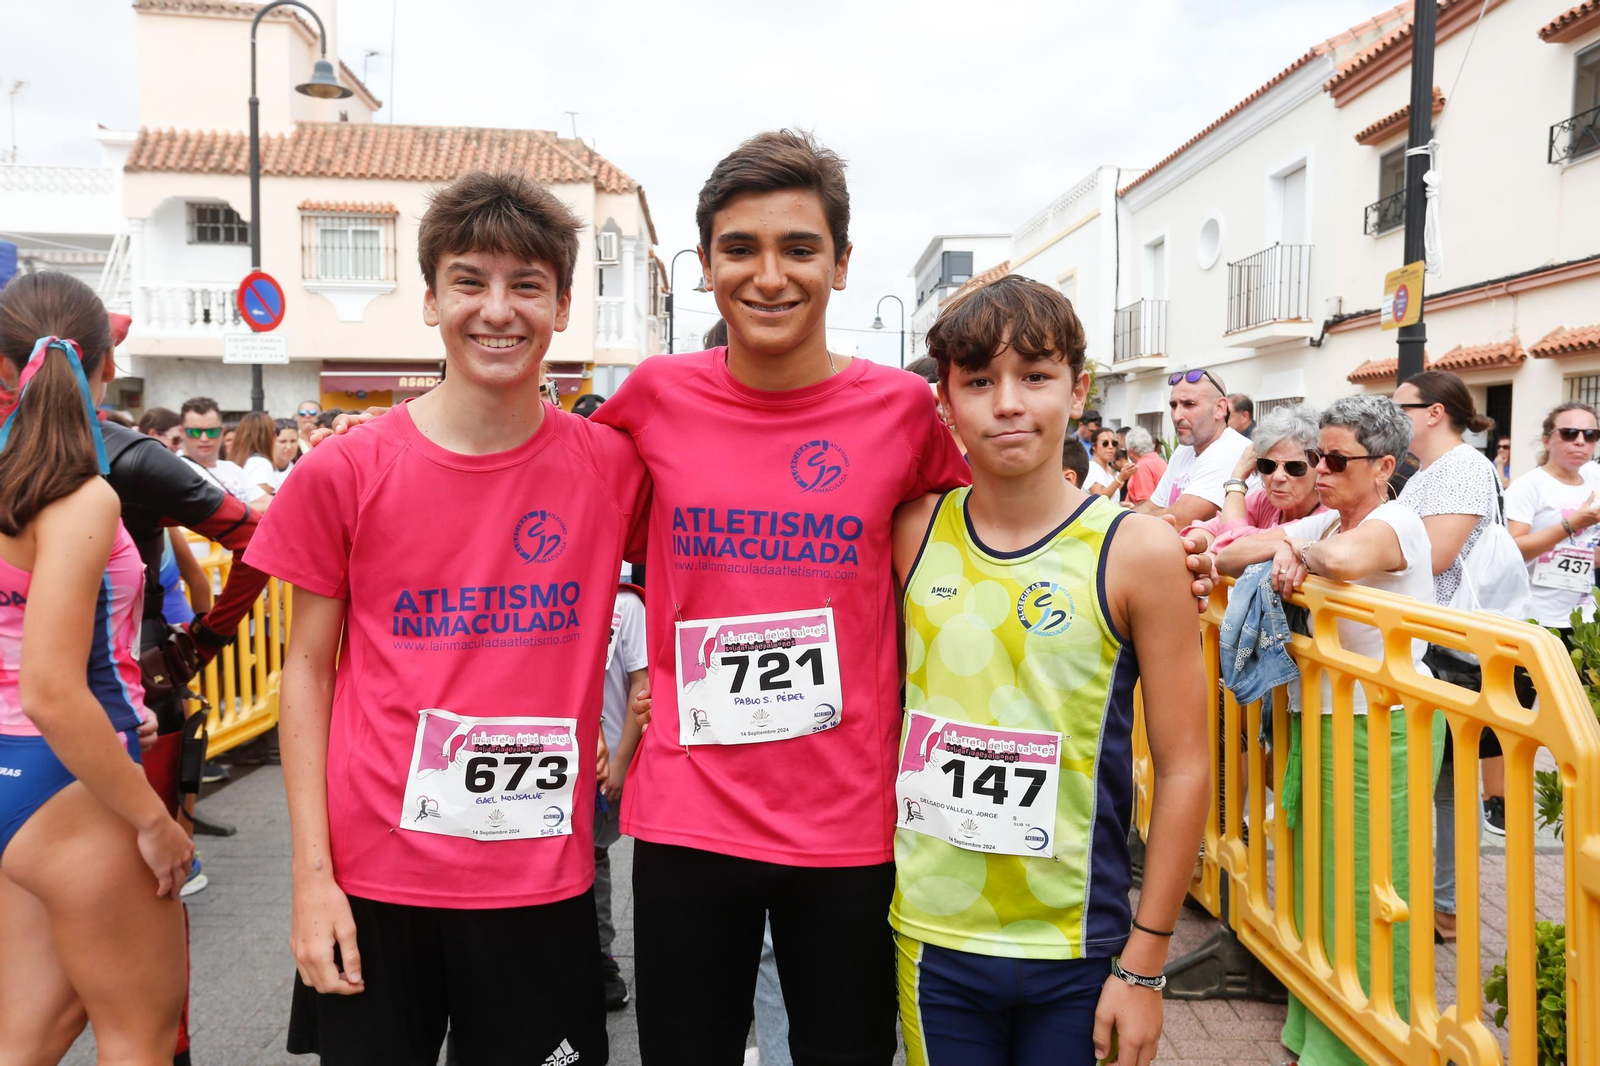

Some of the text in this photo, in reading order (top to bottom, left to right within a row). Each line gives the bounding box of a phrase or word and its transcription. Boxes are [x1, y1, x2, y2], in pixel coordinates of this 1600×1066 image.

[672, 507, 864, 541] ATLETISMO
[672, 535, 859, 566] INMACULADA
[674, 560, 858, 580] www.lainmaculadaatletismo.com
[1557, 559, 1591, 575] 437
[393, 581, 580, 614] ATLETISMO
[931, 586, 957, 596] AMURA
[393, 608, 580, 637] INMACULADA
[393, 632, 580, 651] www.lainmaculadaatletismo.com
[721, 648, 824, 693] 721
[734, 697, 761, 705] PABLO
[763, 696, 772, 704] S.
[748, 729, 776, 737] Septiembre
[465, 756, 568, 793] 673
[941, 758, 1047, 808] 147
[920, 798, 945, 809] DELGADO
[975, 811, 998, 819] JORGE
[954, 838, 981, 848] Septiembre
